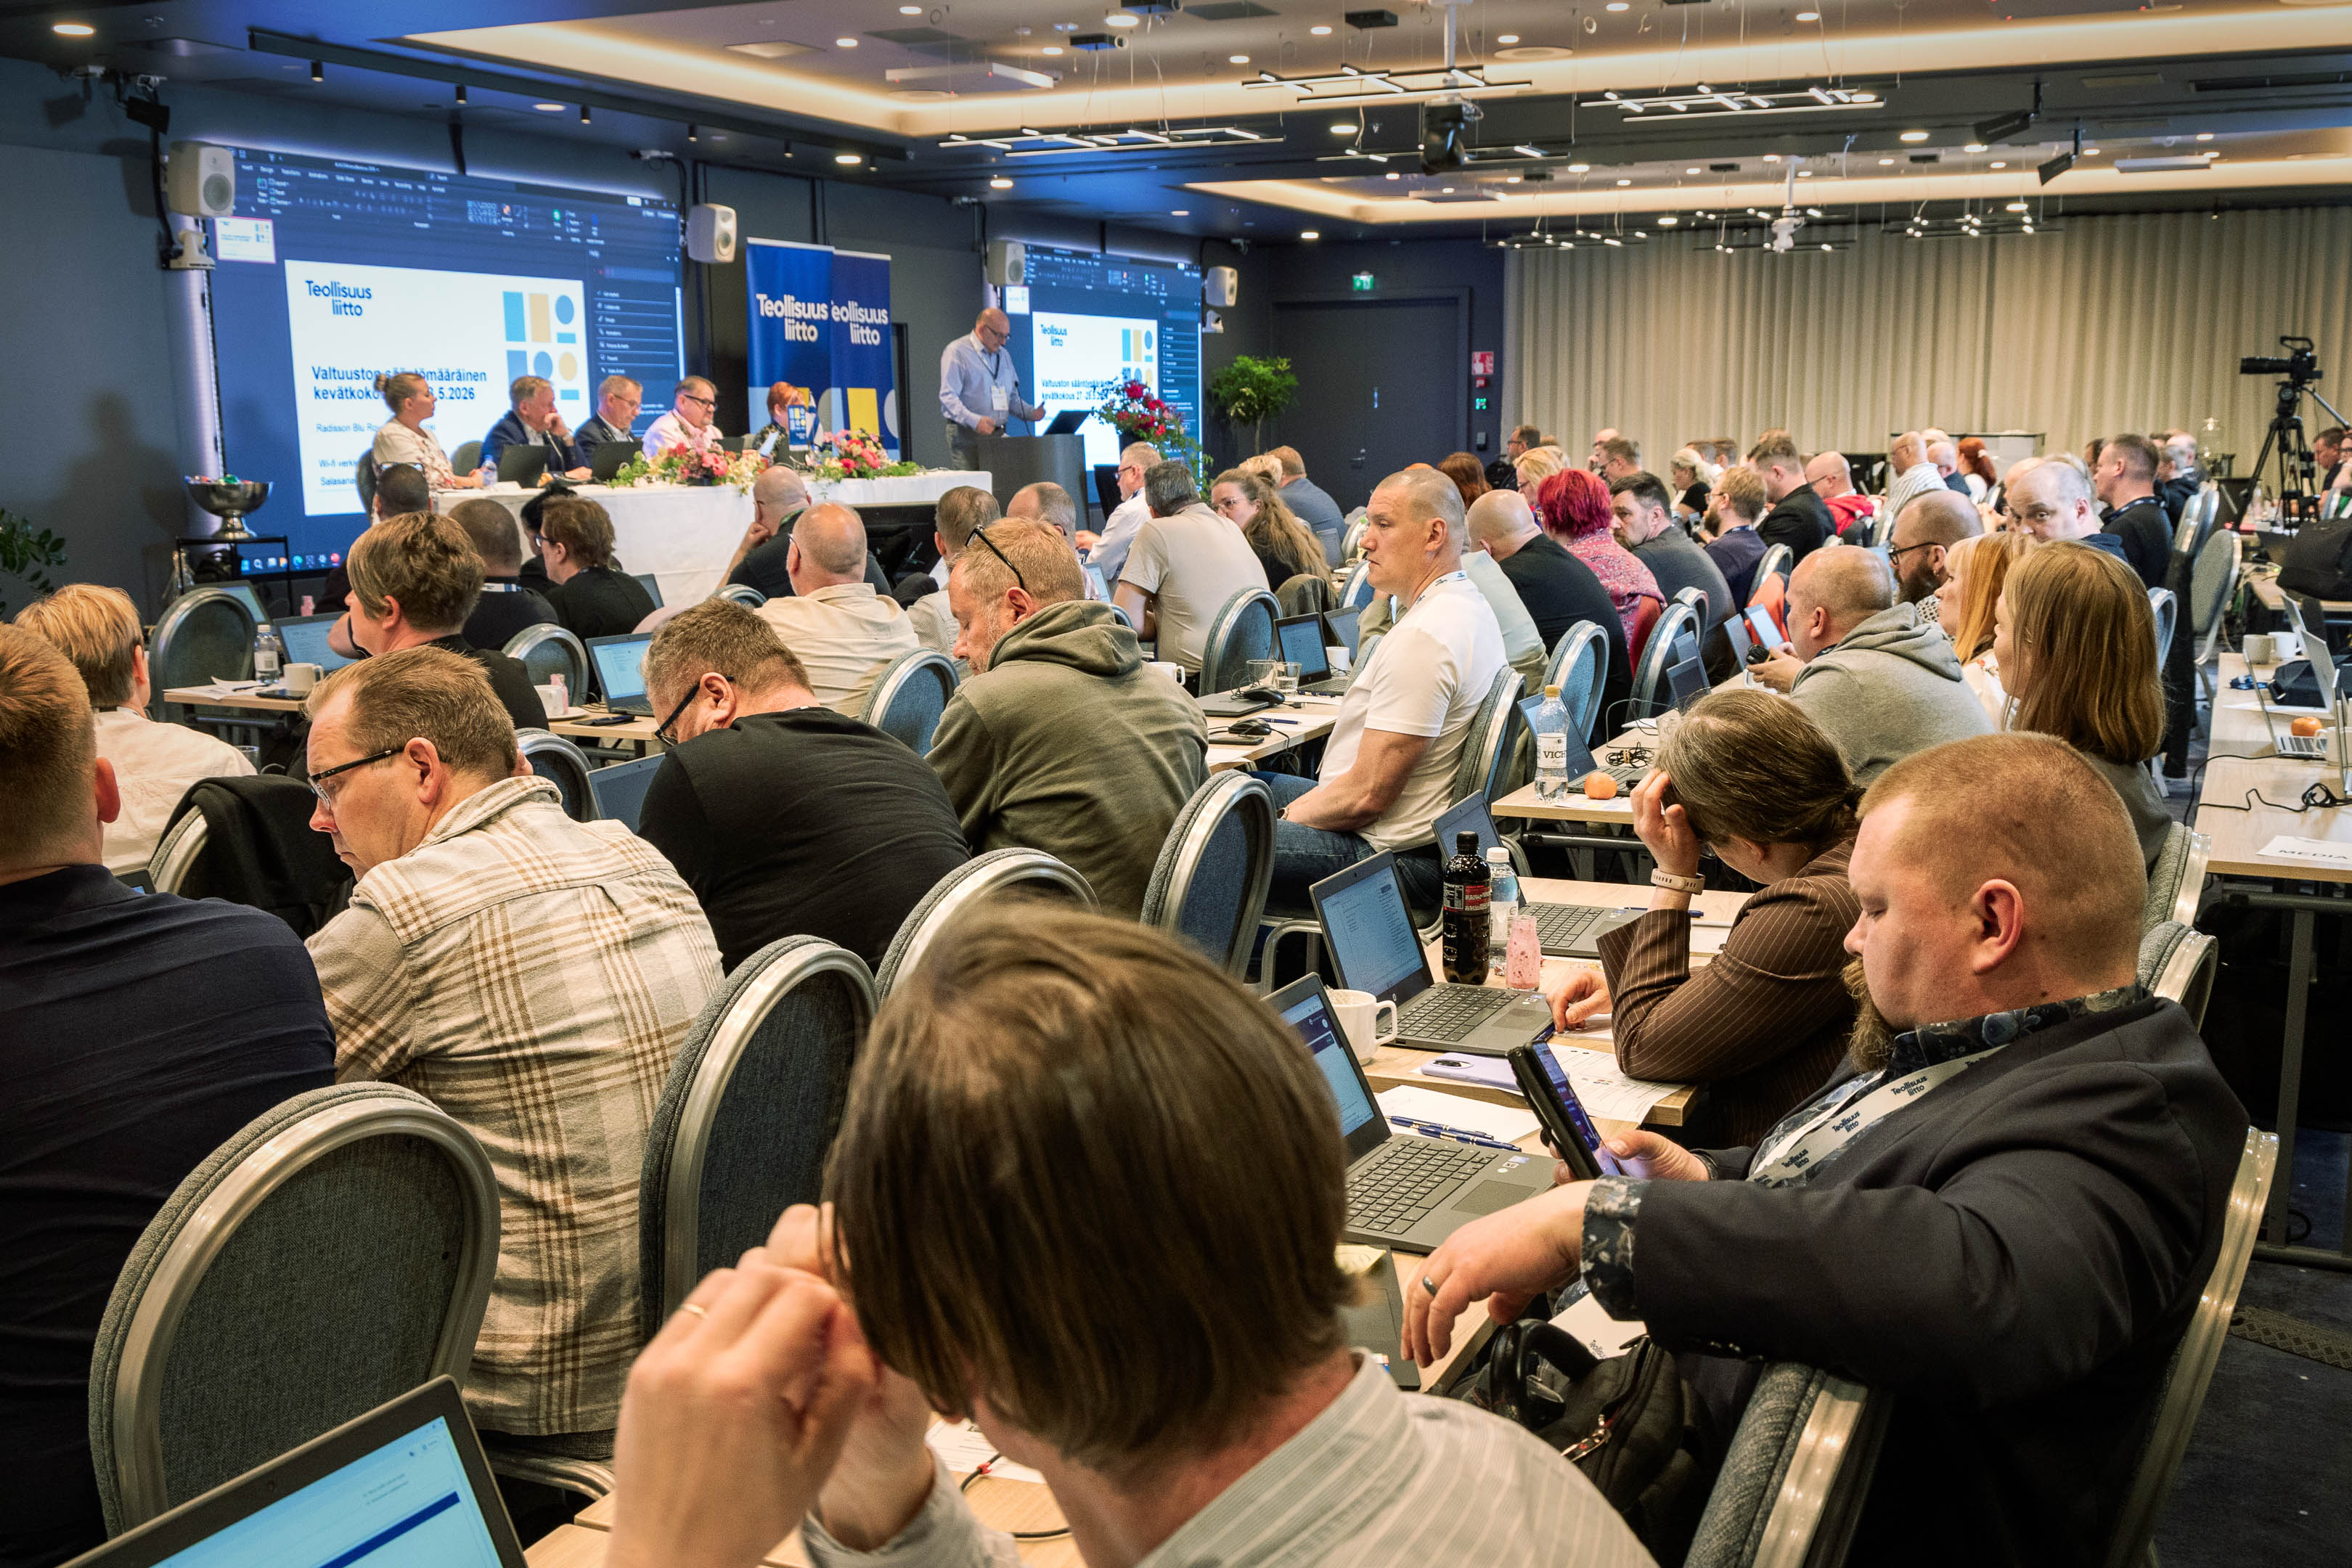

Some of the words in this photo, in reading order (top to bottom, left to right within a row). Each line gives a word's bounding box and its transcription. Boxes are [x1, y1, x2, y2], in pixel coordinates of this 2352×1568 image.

[305, 280, 372, 299] Teollisuus
[332, 300, 363, 316] liitto
[756, 293, 828, 320] Teollisuus
[831, 300, 889, 324] eollisuus
[784, 317, 818, 343] liitto
[849, 322, 881, 346] liitto
[385, 367, 487, 381] sätömääräinen
[314, 386, 380, 400] kevätkoko
[2279, 849, 2348, 859] MEDIA
[1891, 1076, 1927, 1095] Teollisuus
[1907, 1085, 1924, 1096] liitto
[1832, 1111, 1861, 1133] Teollisuus
[1845, 1121, 1859, 1132] liitto
